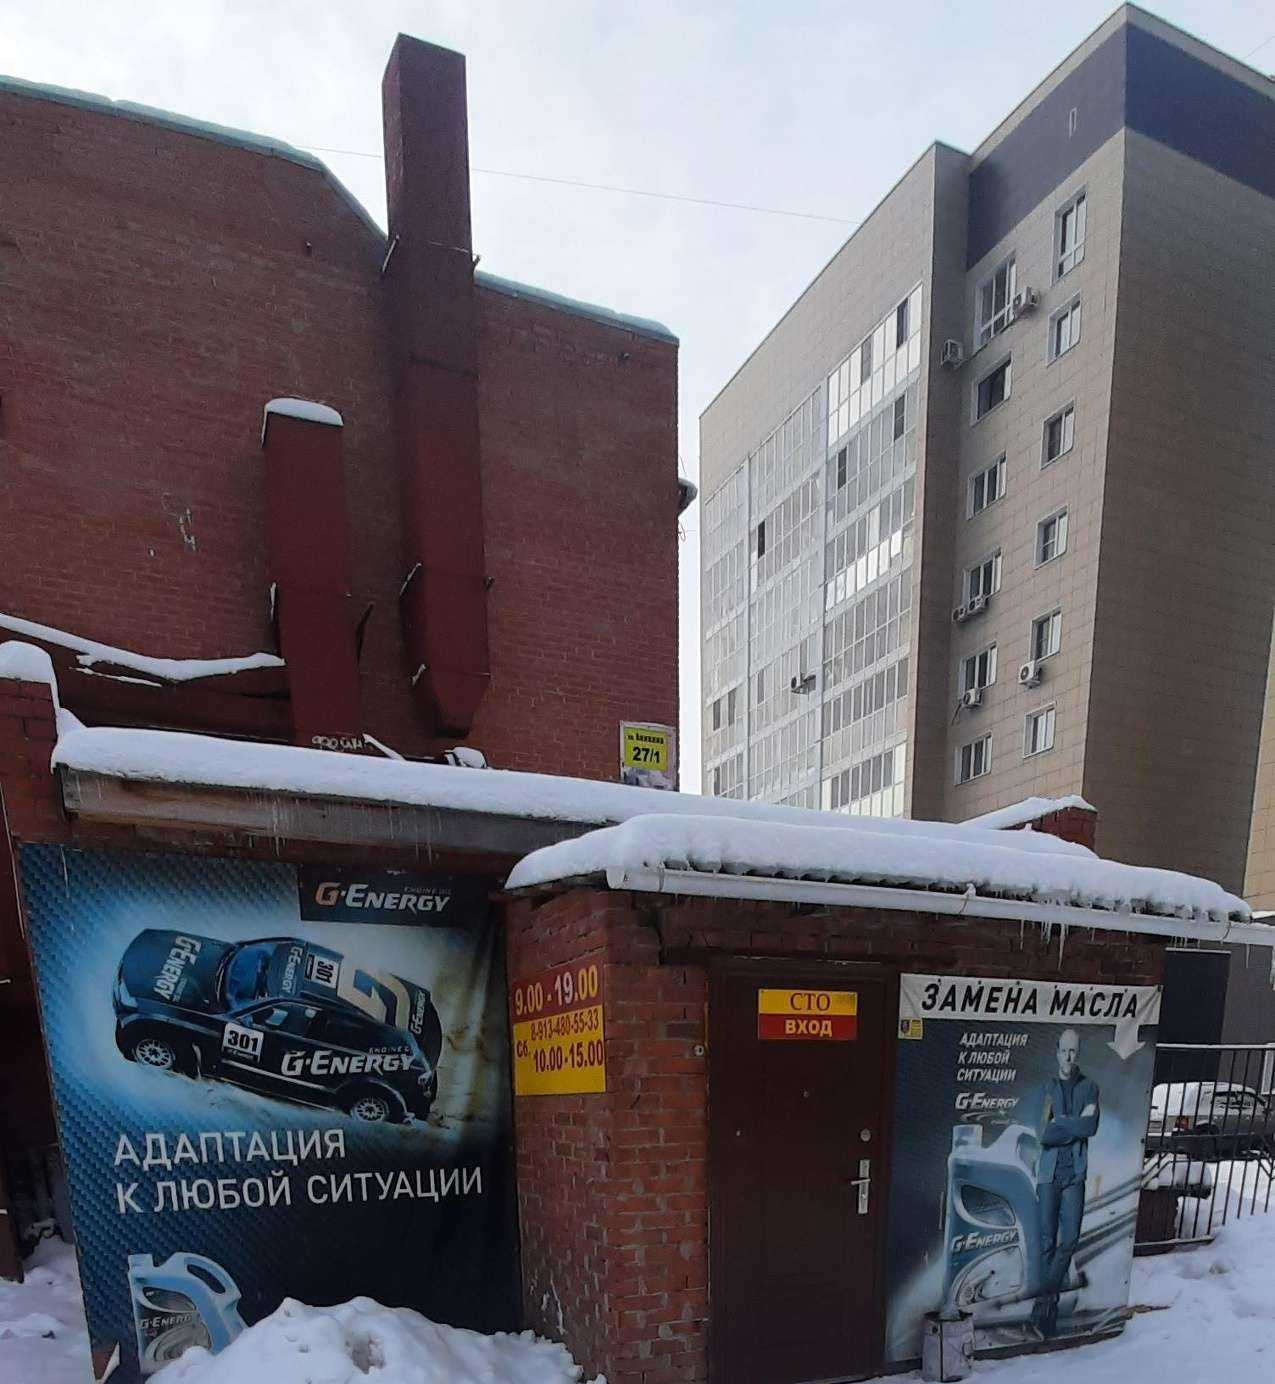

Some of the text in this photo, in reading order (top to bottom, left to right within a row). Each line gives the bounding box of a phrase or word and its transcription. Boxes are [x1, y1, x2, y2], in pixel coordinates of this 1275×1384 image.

[632, 746, 660, 764] 27/1
[315, 960, 334, 984] 301
[515, 982, 544, 1016] 9.00
[554, 964, 599, 1006] 19.00
[789, 992, 832, 1011] СТО
[921, 983, 1138, 1019] ЗАМЕНА МАСЛА
[784, 1019, 833, 1038] ВХОД
[227, 1030, 259, 1053] 301
[959, 1032, 1029, 1049] АДАПТАЦИЯ
[957, 1049, 1011, 1065] К ЛЮБОЙ
[957, 1067, 1017, 1083] СИТУАЦИИ
[114, 1129, 346, 1171] АДАПТАЦИЯ
[115, 1166, 483, 1215] К ЛЮБОЙ СИТУАЦИИ
